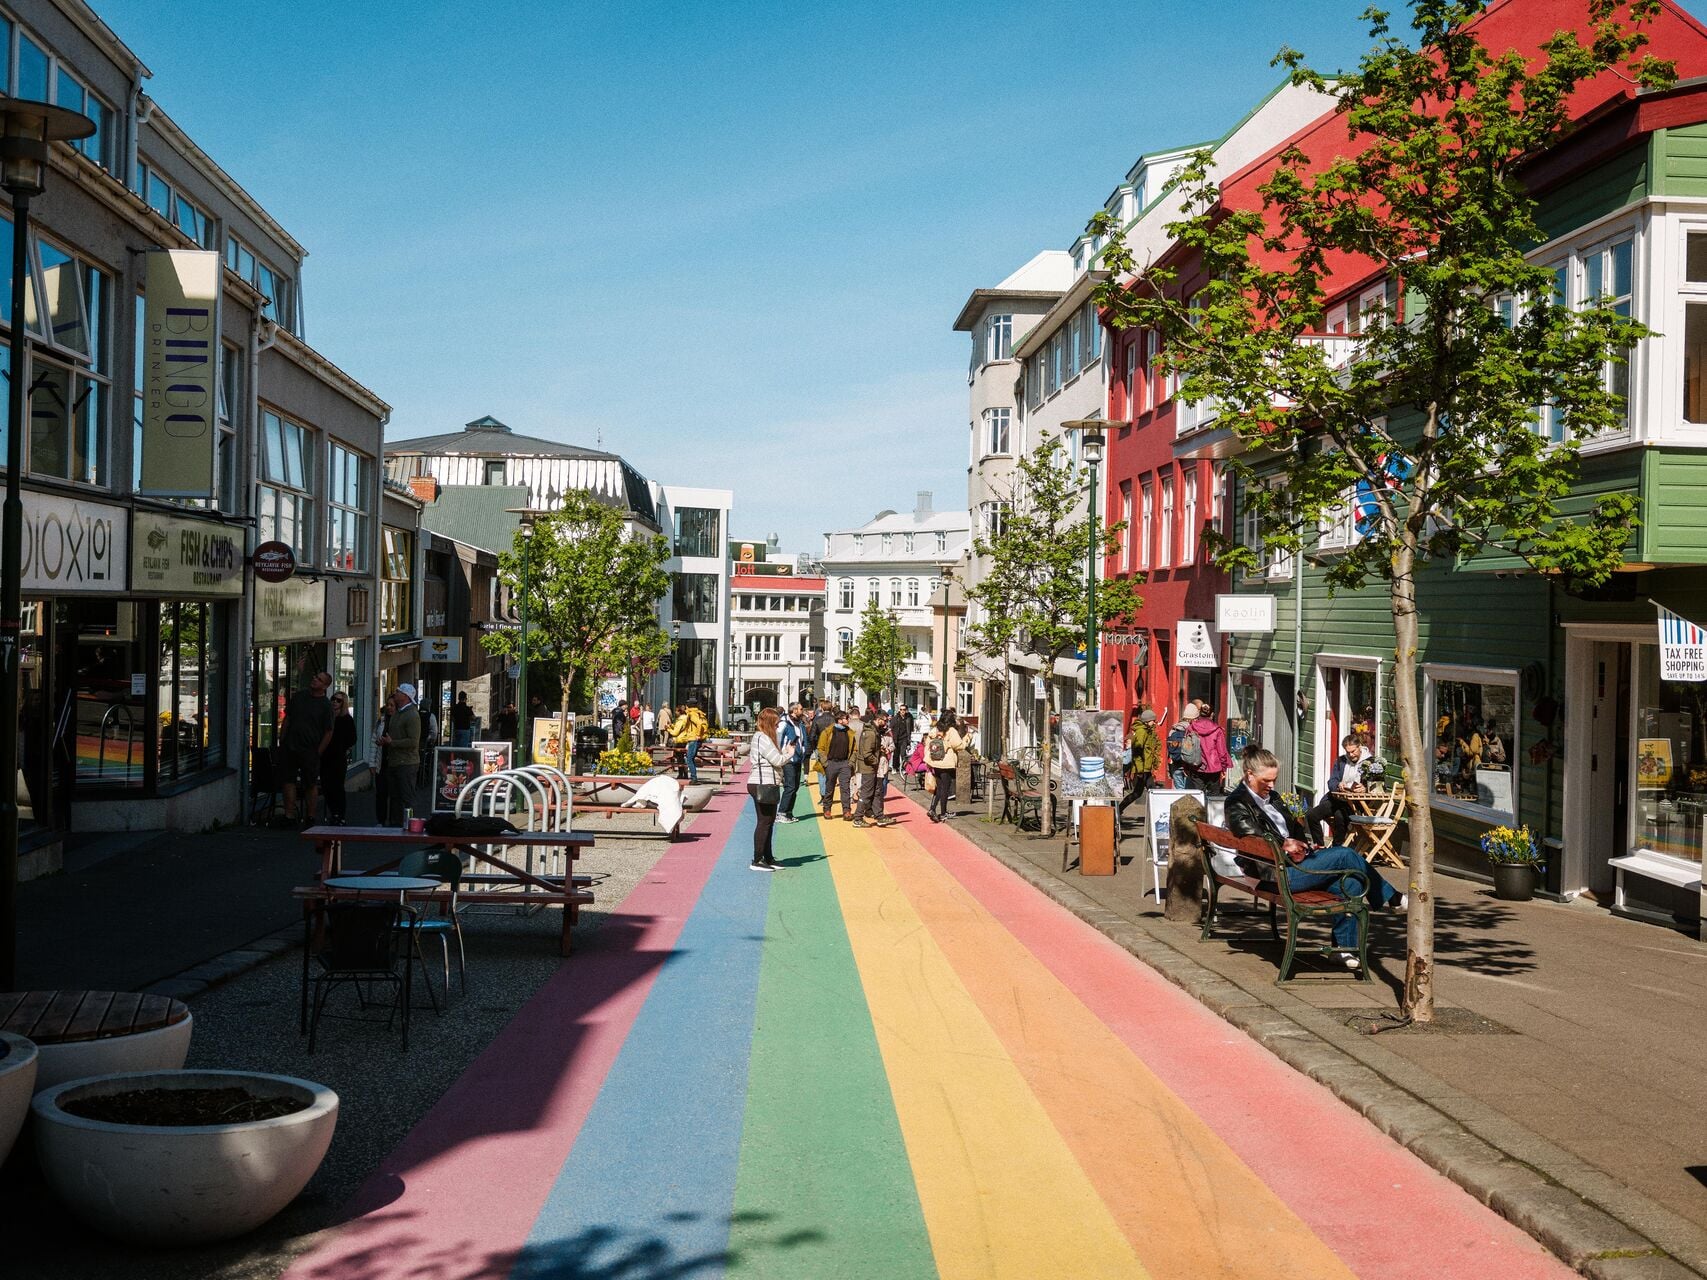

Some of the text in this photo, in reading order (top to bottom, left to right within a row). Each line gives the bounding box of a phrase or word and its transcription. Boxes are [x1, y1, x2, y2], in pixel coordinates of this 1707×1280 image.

[151, 323, 161, 422] DRINKERY
[164, 308, 208, 437] BINGO
[181, 529, 234, 570] FISH & CHIPS
[736, 563, 756, 576] loft
[193, 571, 222, 586] RESTAURANT
[1224, 608, 1266, 618] Kaolin
[1665, 648, 1704, 660] TAX FREE
[1665, 661, 1705, 671] SHOPPING
